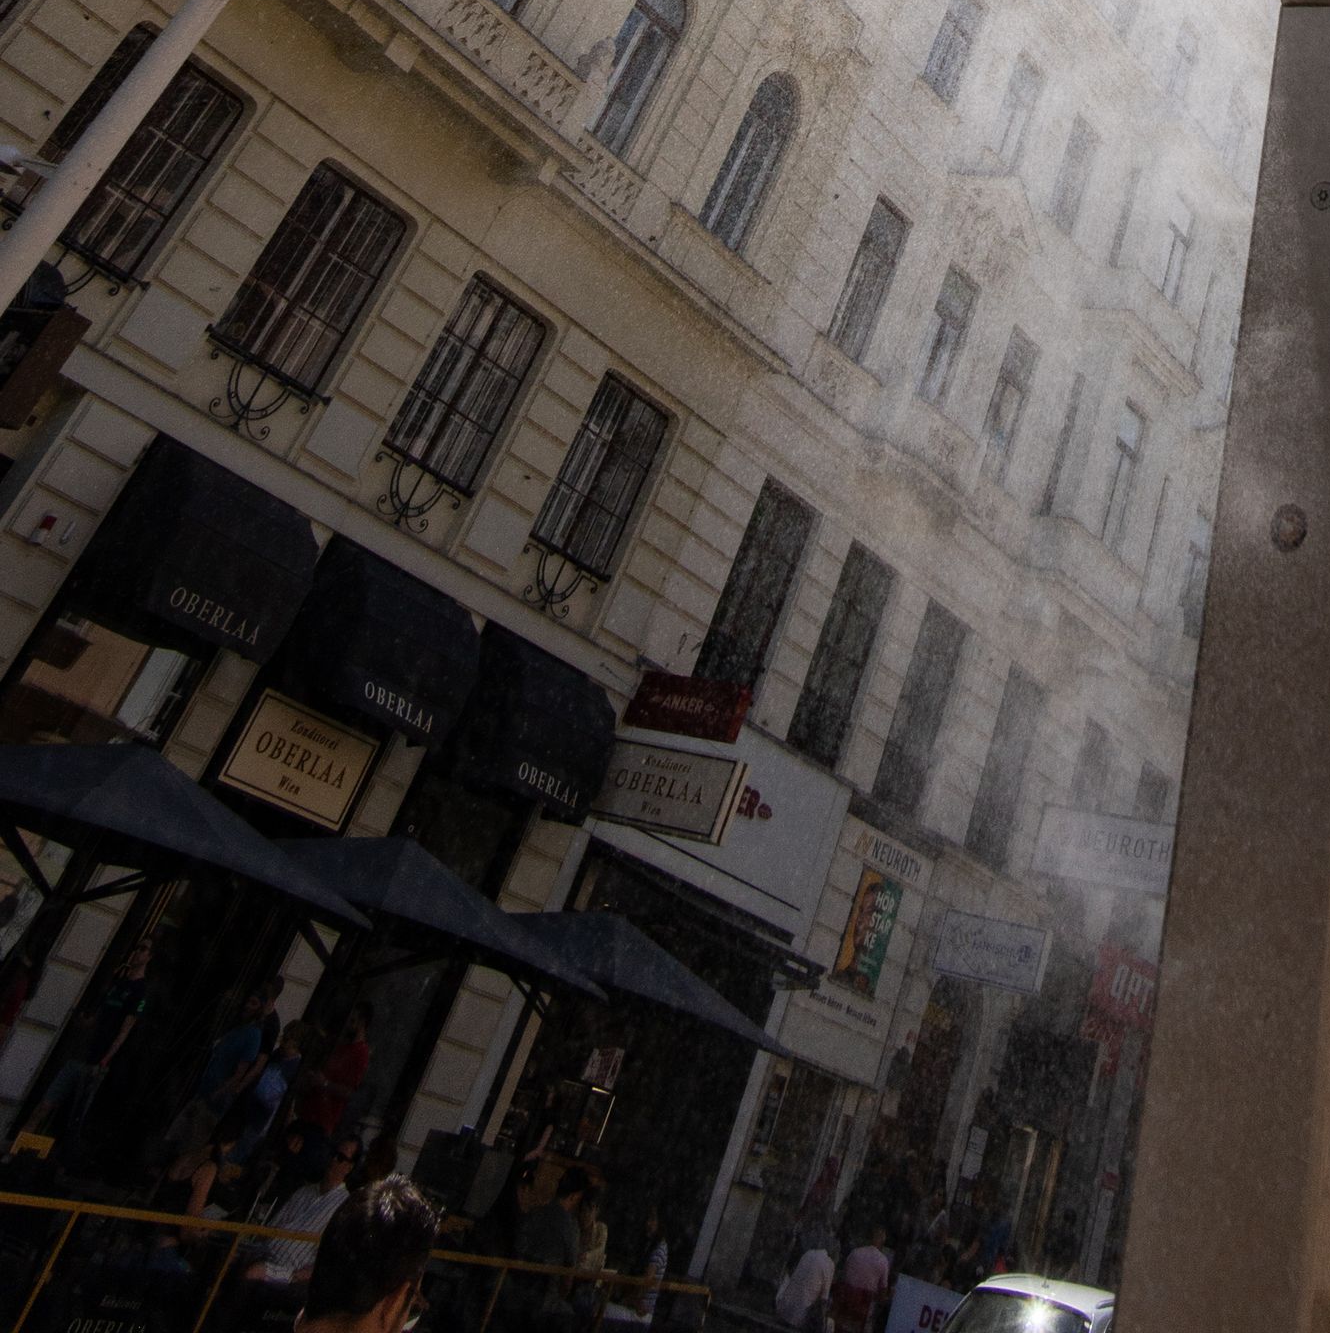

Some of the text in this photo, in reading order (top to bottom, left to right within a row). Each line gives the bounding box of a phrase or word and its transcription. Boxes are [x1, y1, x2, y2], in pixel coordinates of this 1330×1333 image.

[169, 585, 261, 647] OBERLAA
[364, 680, 434, 734] OBERLAA
[660, 694, 704, 714] ANKER
[255, 731, 346, 789] OBERLAA
[278, 775, 300, 796] Wien
[518, 761, 578, 808] OBERLAA
[614, 767, 703, 805] OBERLAA
[871, 840, 921, 883] NEUROTH
[863, 930, 878, 951] KE
[919, 1304, 948, 1332] DE
